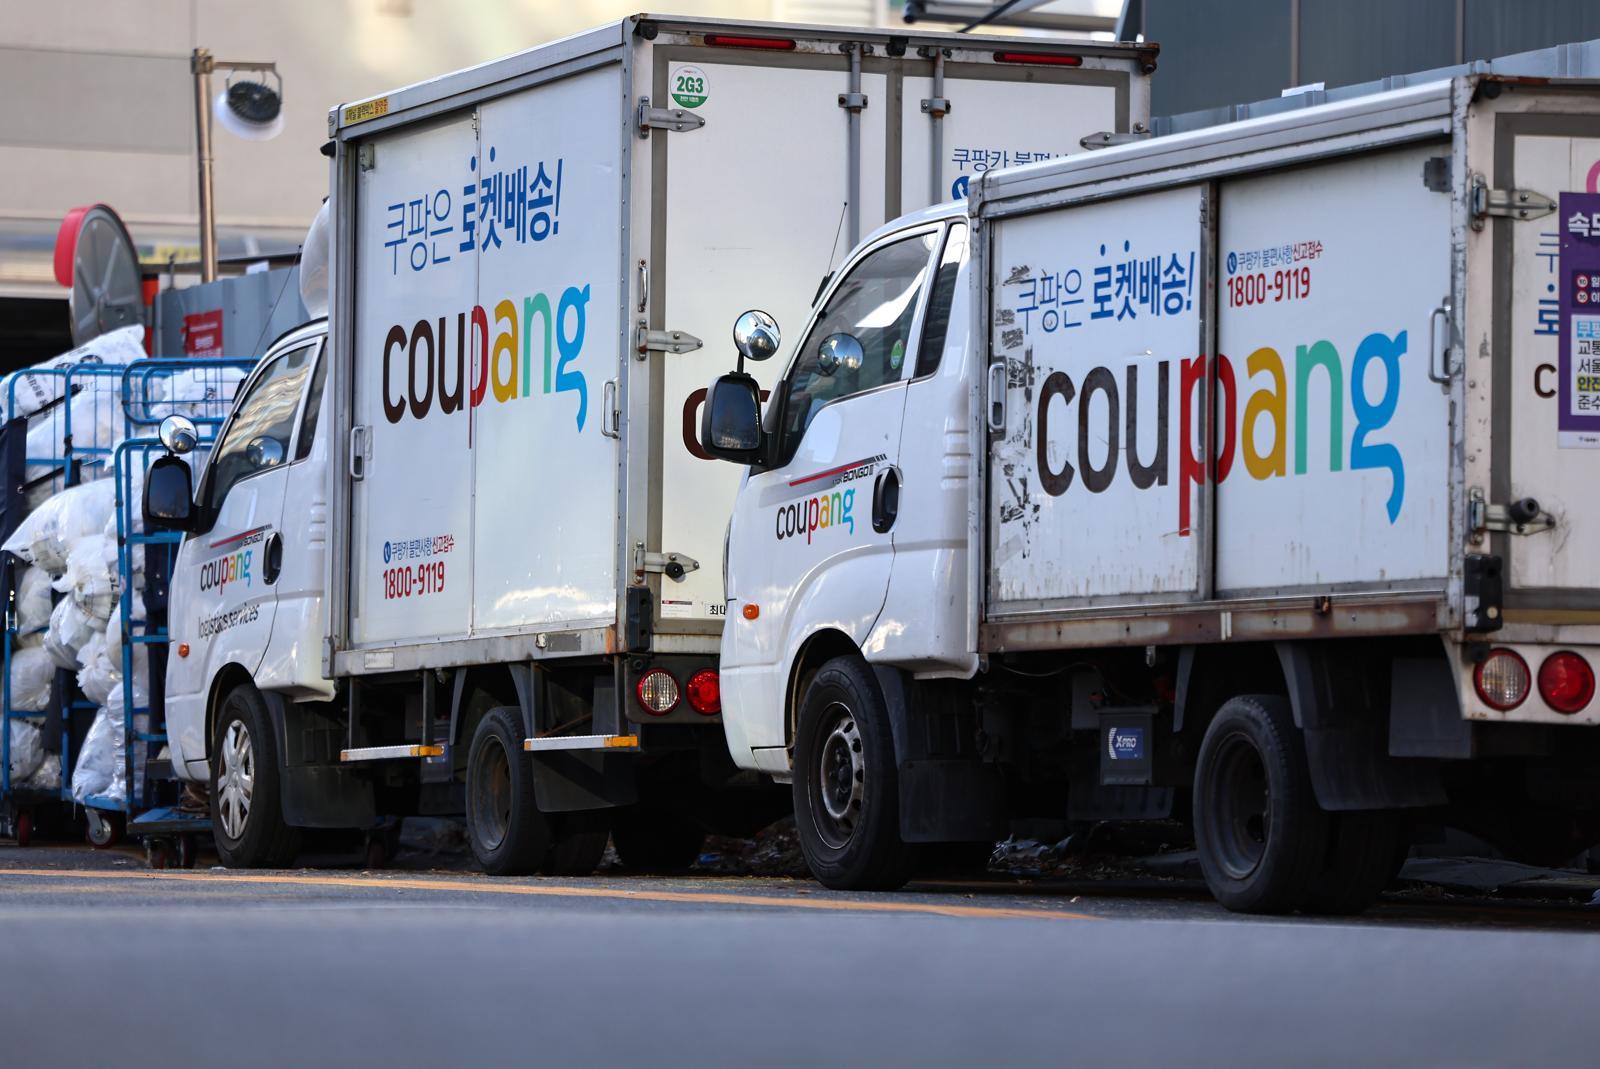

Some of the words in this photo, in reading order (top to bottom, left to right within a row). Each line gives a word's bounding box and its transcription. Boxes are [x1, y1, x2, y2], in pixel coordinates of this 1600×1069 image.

[676, 75, 704, 94] 2G3
[951, 148, 1009, 172] 쿠팡카
[384, 189, 454, 276] 쿠팡은
[459, 157, 563, 254] 로켓배송!
[1016, 268, 1085, 336] 쿠팡은
[1090, 250, 1196, 322] 로켓배송!
[1227, 266, 1311, 308] 1800-9119
[382, 283, 590, 449] coupang
[1036, 329, 1408, 537] coupang
[776, 488, 856, 545] coupang
[200, 550, 252, 595] coupang
[383, 561, 445, 600] 1800-9119
